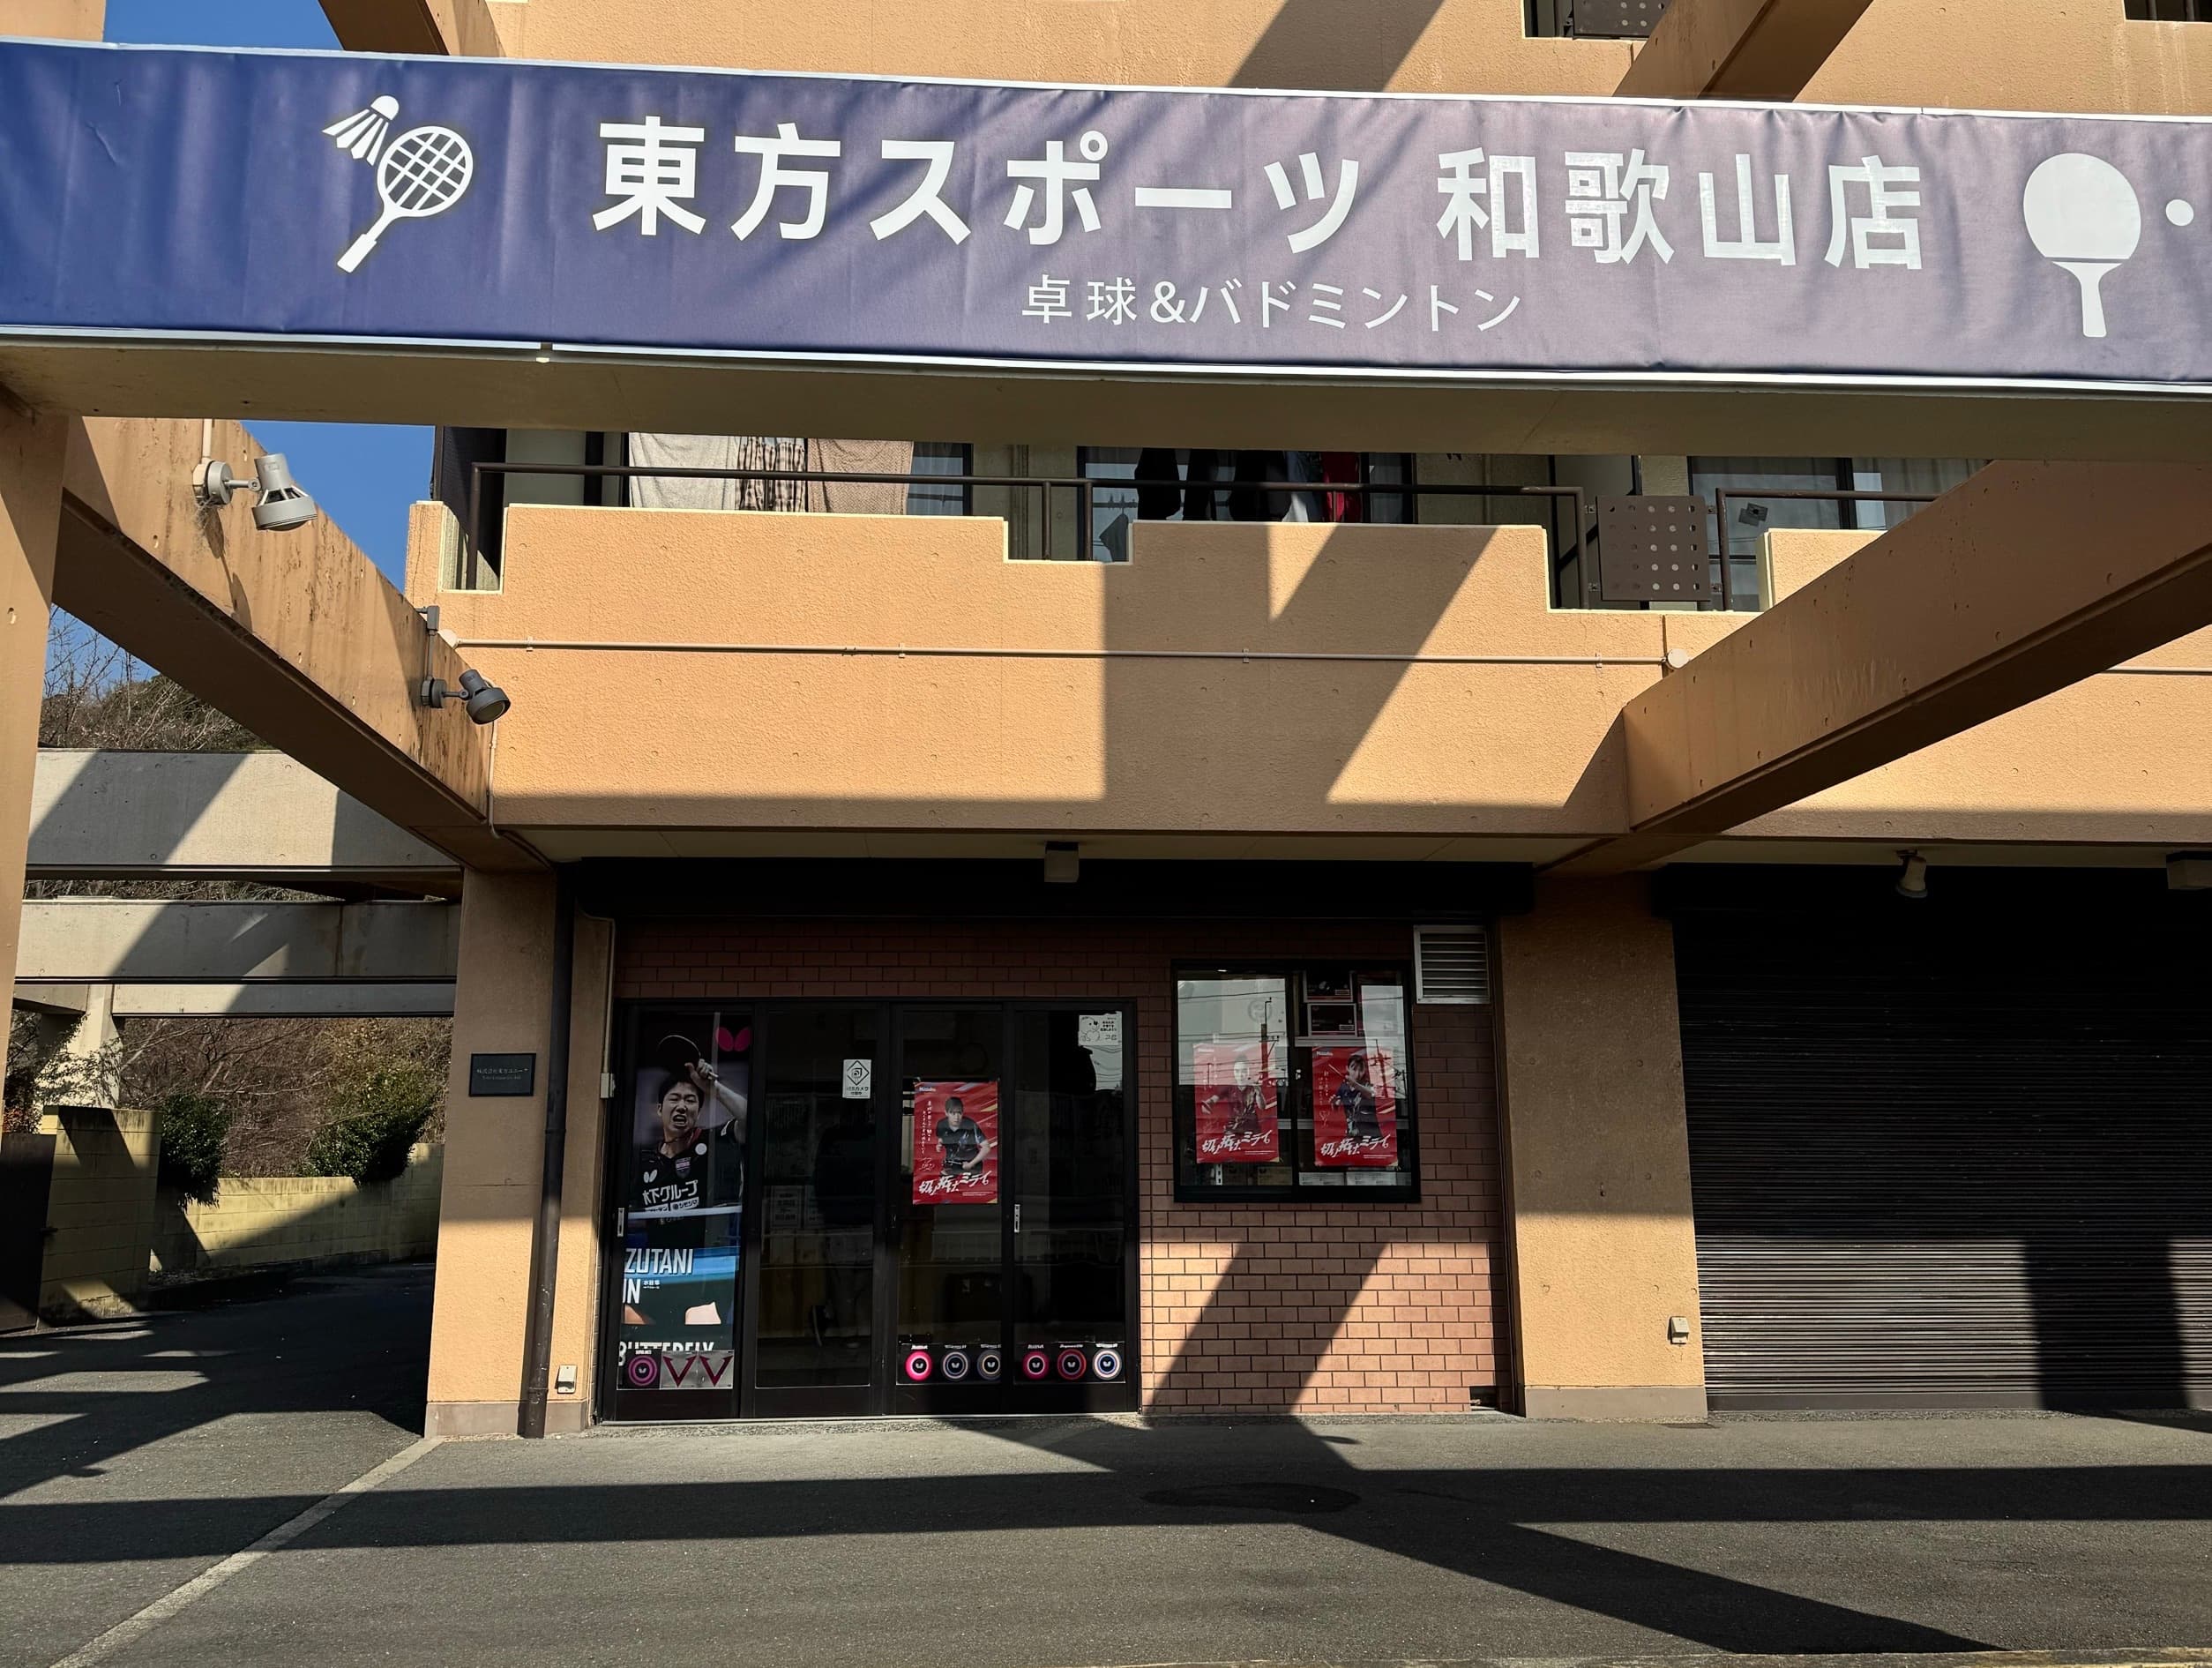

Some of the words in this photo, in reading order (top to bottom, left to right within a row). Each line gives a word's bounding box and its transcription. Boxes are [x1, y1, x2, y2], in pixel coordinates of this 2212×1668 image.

[593, 116, 1359, 254] 東方スポーツ
[1437, 146, 1924, 270] 和歌山店
[1021, 274, 1521, 333] 卓球&バドミントン
[642, 1179, 699, 1206] 木下グループ
[624, 1248, 693, 1274] ZUTANI
